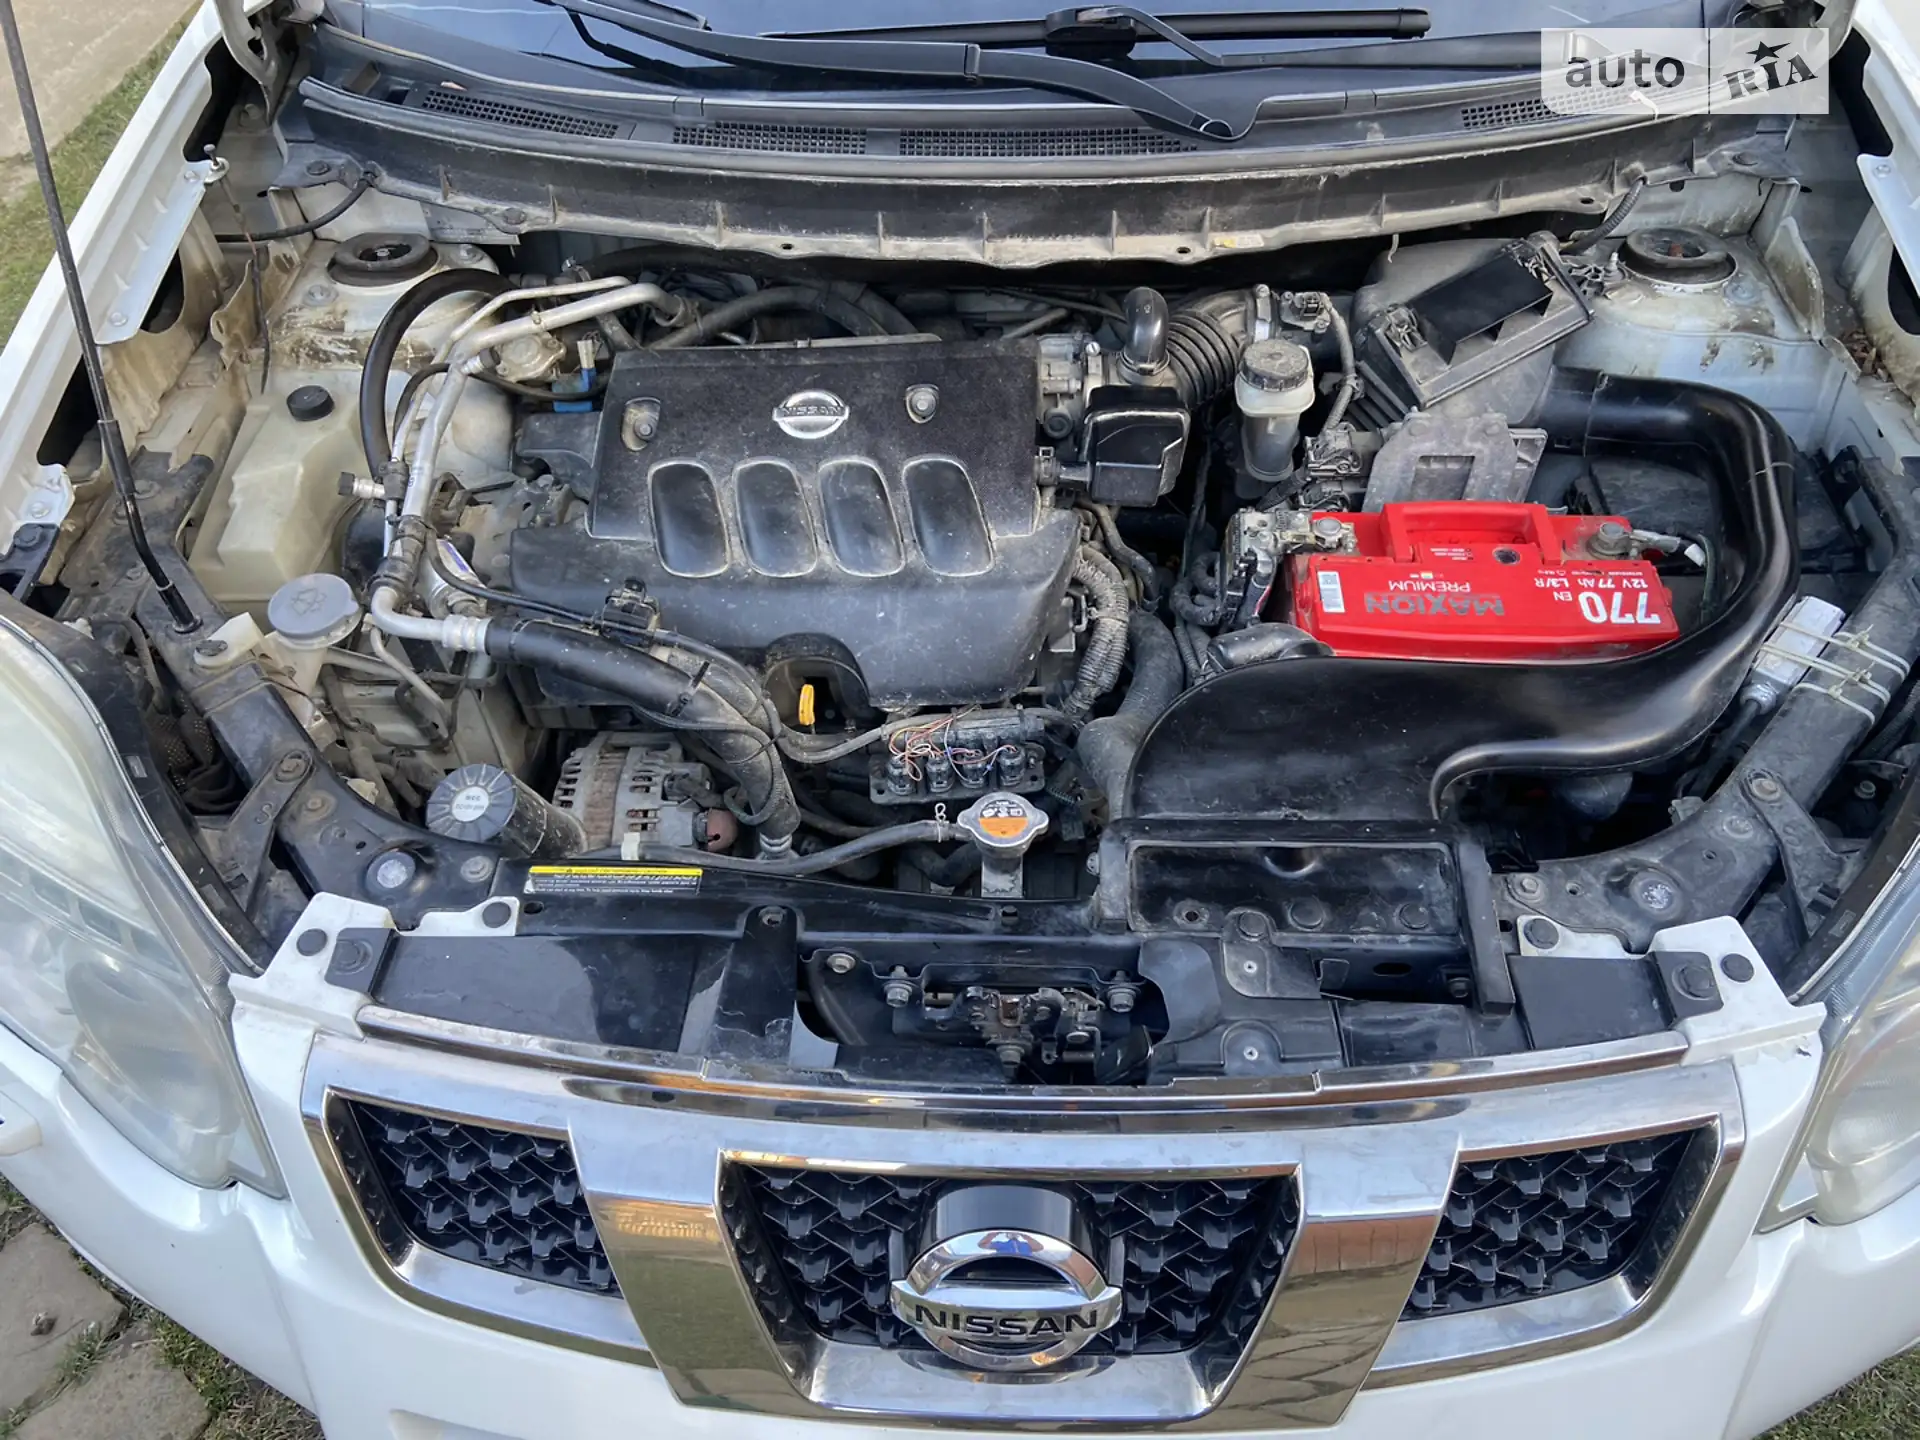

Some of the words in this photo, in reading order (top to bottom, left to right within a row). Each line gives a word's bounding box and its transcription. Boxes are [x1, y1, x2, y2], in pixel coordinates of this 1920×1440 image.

[1388, 580, 1472, 593] PREMIUM
[1597, 577, 1616, 589] 77
[1621, 577, 1649, 589] 12V
[1552, 591, 1573, 602] EN
[1363, 593, 1506, 616] MAXION
[1577, 591, 1662, 625] 770
[914, 1304, 1098, 1337] NISSAN
